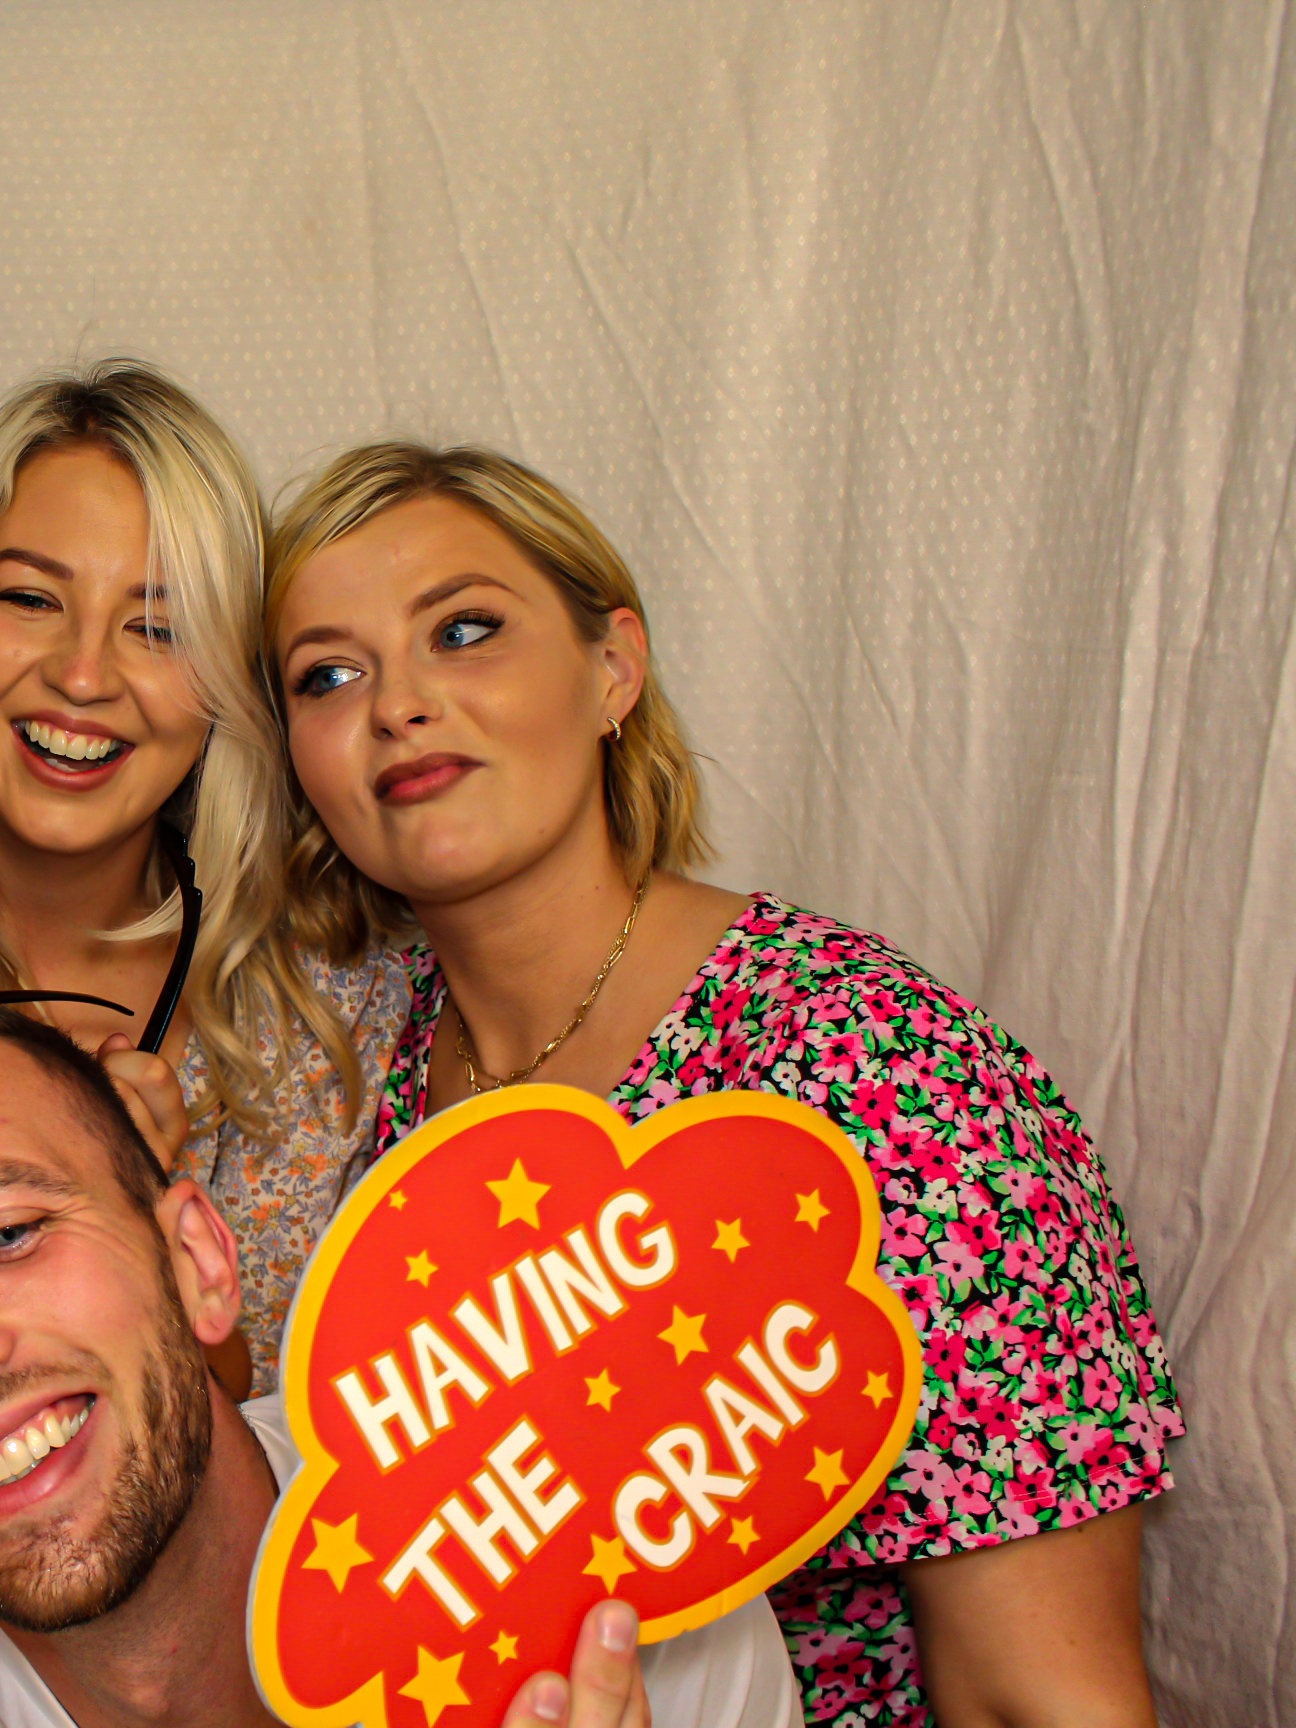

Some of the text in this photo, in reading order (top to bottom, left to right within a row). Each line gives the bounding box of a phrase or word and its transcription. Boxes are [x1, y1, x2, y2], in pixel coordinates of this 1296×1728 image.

[334, 1191, 676, 1469] HAVING
[614, 1303, 839, 1569] CRAIC
[381, 1419, 581, 1627] THE
